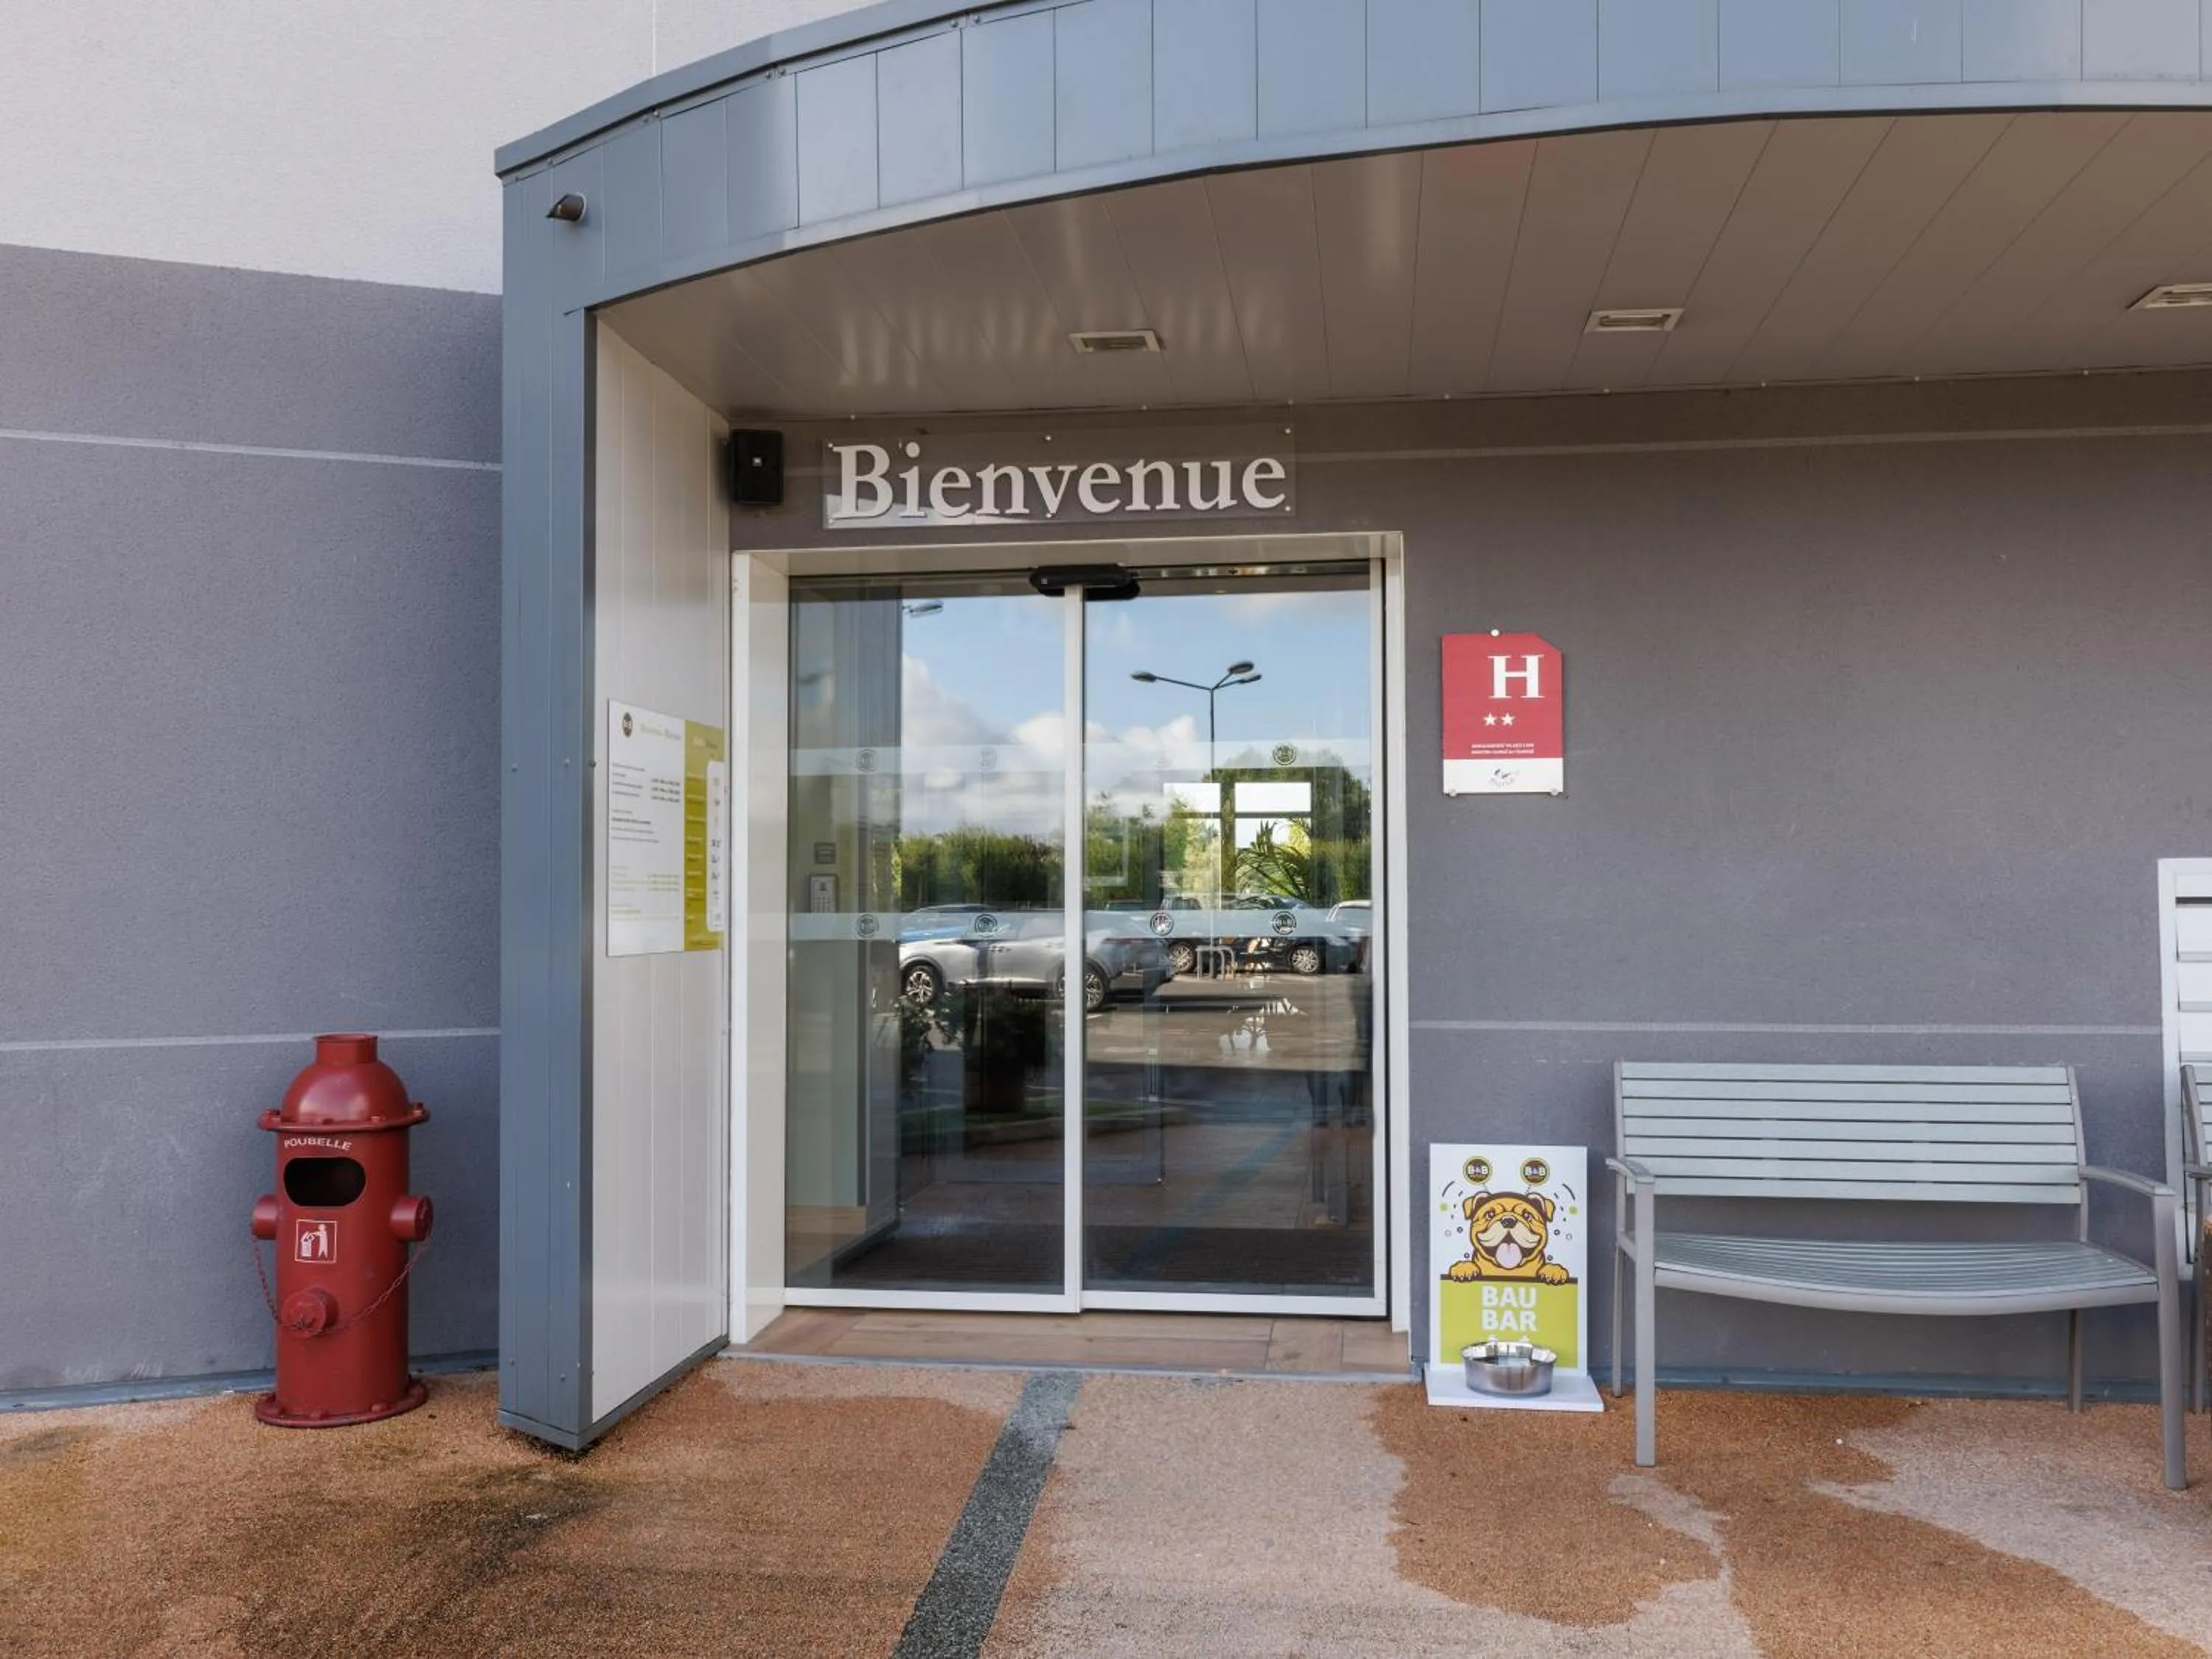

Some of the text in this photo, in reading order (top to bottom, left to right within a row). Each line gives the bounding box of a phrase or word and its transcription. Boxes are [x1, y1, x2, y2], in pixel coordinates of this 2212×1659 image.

[832, 442, 1286, 519] Bienvenue
[1488, 655, 1545, 699] H
[284, 1137, 352, 1150] POUBELLE
[1482, 1285, 1537, 1308] BAU
[1482, 1309, 1537, 1332] BAR
